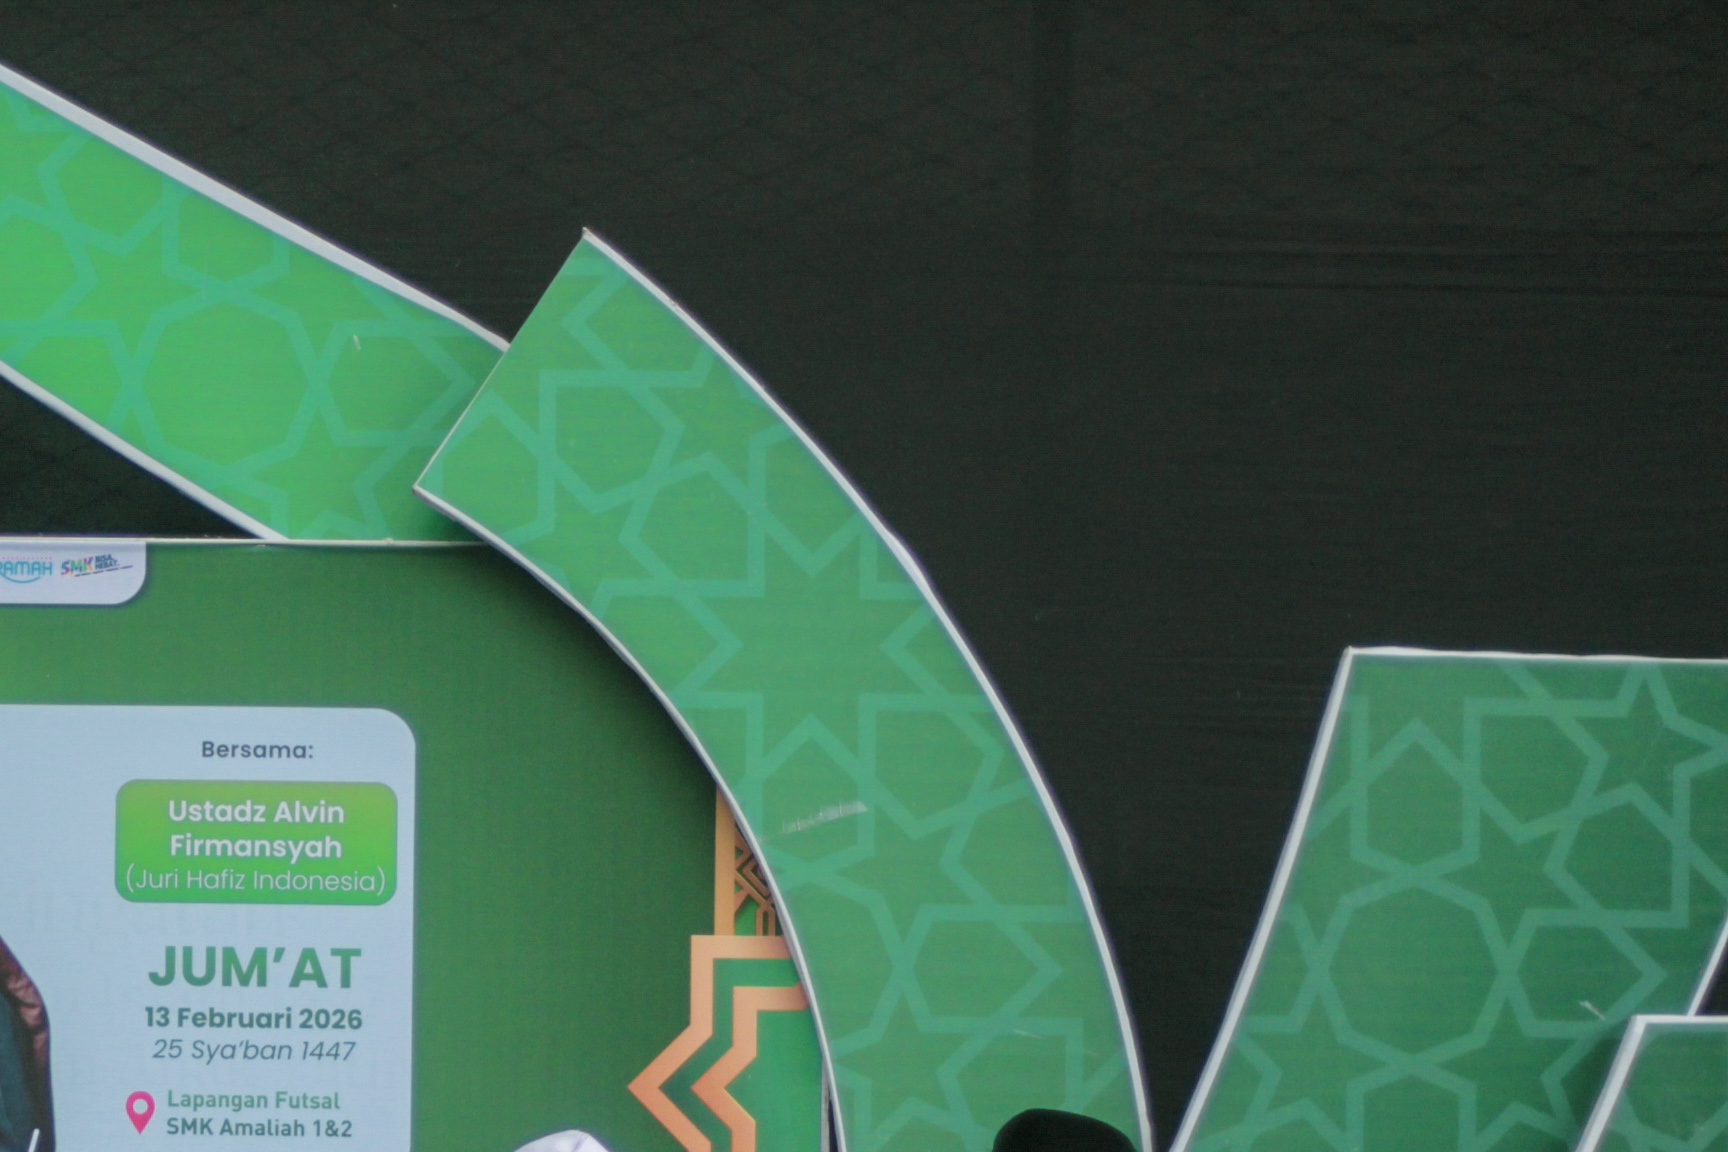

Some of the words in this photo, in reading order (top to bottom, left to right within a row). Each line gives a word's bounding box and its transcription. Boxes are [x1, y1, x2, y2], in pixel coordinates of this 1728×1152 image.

[61, 556, 94, 575] SMK
[201, 740, 314, 759] Bersama:
[168, 799, 266, 823] Ustadz
[273, 799, 345, 824] Alvin
[170, 833, 342, 864] Firmansyah
[126, 862, 179, 893] (Juri
[187, 868, 245, 889] Hafiz
[253, 866, 386, 896] Indonesia)
[148, 945, 362, 988] JUM'AT
[145, 1005, 170, 1027] 13
[177, 1006, 292, 1029] Februari
[299, 1008, 363, 1030] 2026
[152, 1038, 183, 1059] 25
[191, 1039, 293, 1066] Sya'ban
[302, 1040, 356, 1061] 1447
[168, 1089, 268, 1112] Lapangan
[275, 1090, 340, 1110] Futsal
[166, 1117, 214, 1136] SMK
[219, 1118, 305, 1137] Amaliah
[313, 1119, 353, 1138] 1&2
